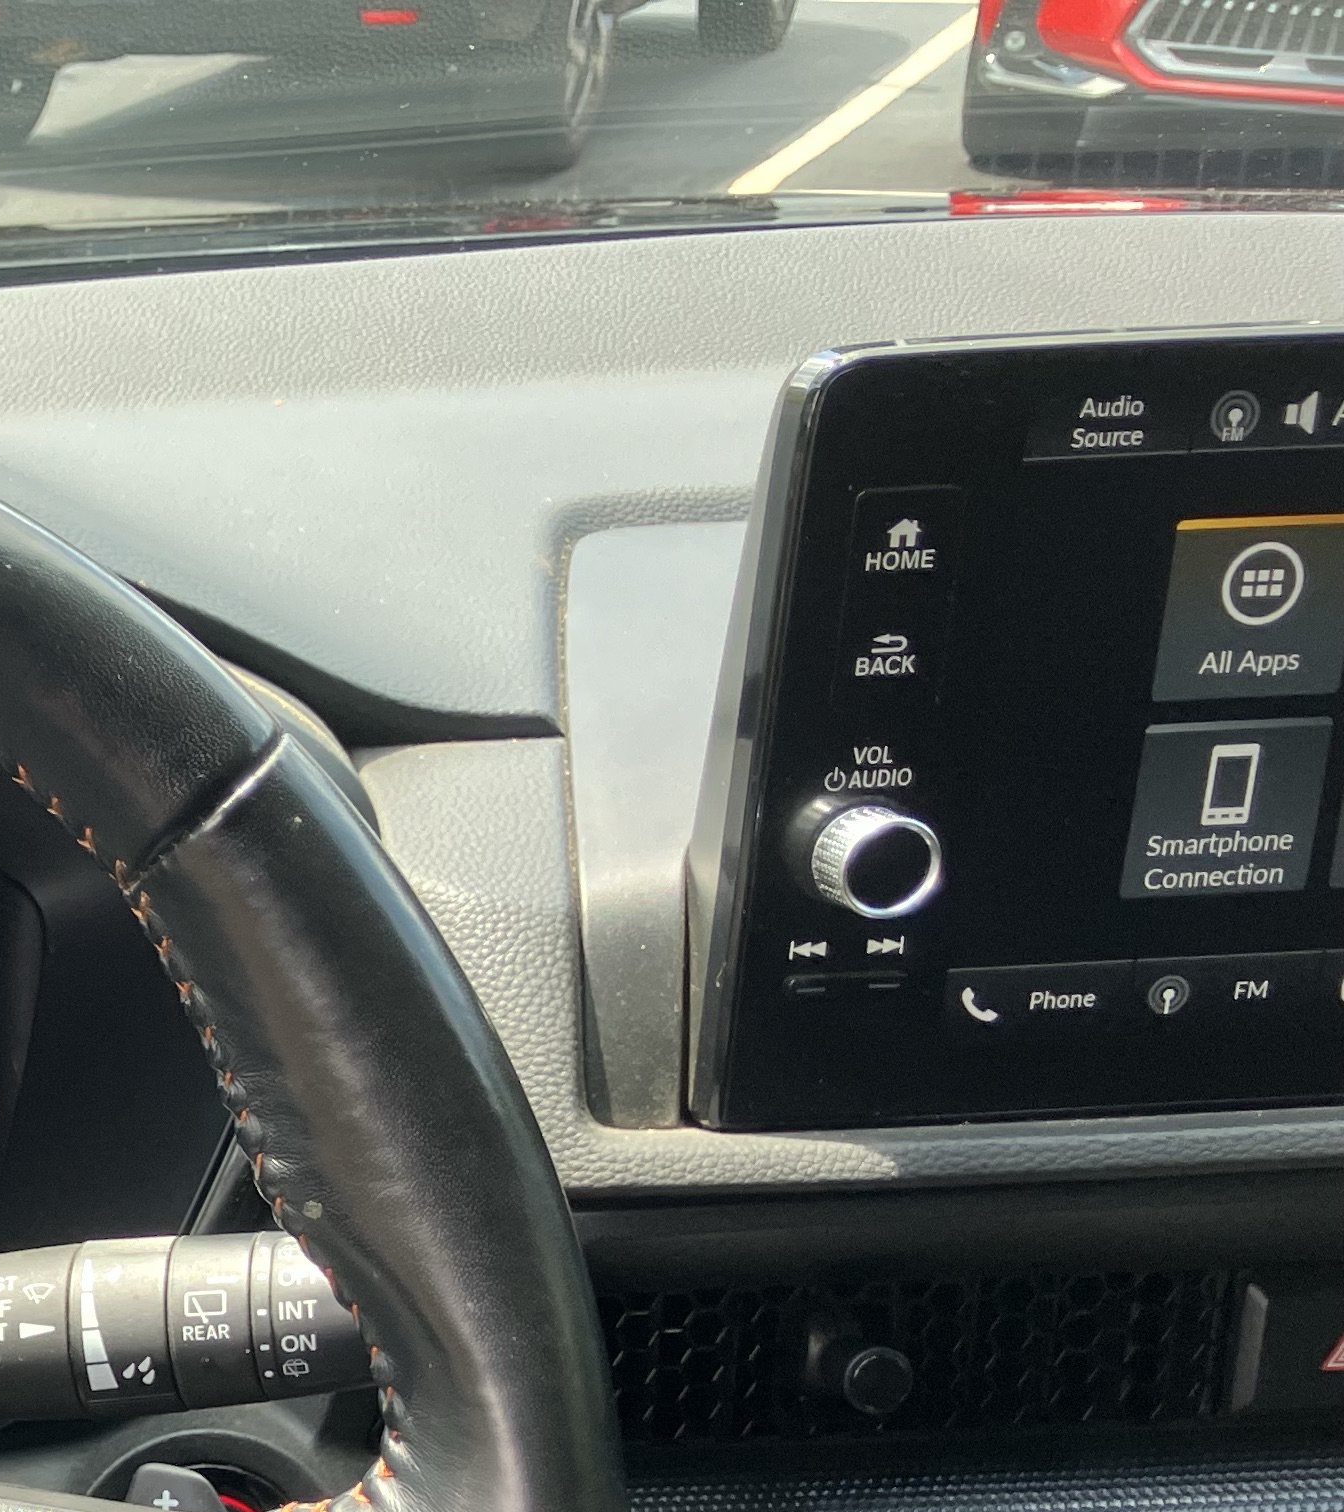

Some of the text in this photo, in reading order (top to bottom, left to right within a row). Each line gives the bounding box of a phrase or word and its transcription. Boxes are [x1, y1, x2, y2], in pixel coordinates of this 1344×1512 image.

[1079, 396, 1144, 420] Audio
[1070, 426, 1144, 450] Source
[865, 550, 936, 572] HOME
[854, 654, 916, 678] BACK
[1198, 650, 1300, 678] All Apps
[853, 745, 893, 766] VOL
[847, 767, 912, 790] AUDIO
[1146, 830, 1294, 859] Smartphone
[1144, 864, 1284, 891] Connection
[1029, 989, 1096, 1010] Phone
[1233, 979, 1269, 1000] FM
[278, 1299, 317, 1321] INT
[182, 1323, 230, 1341] REAR
[280, 1333, 317, 1353] ON
